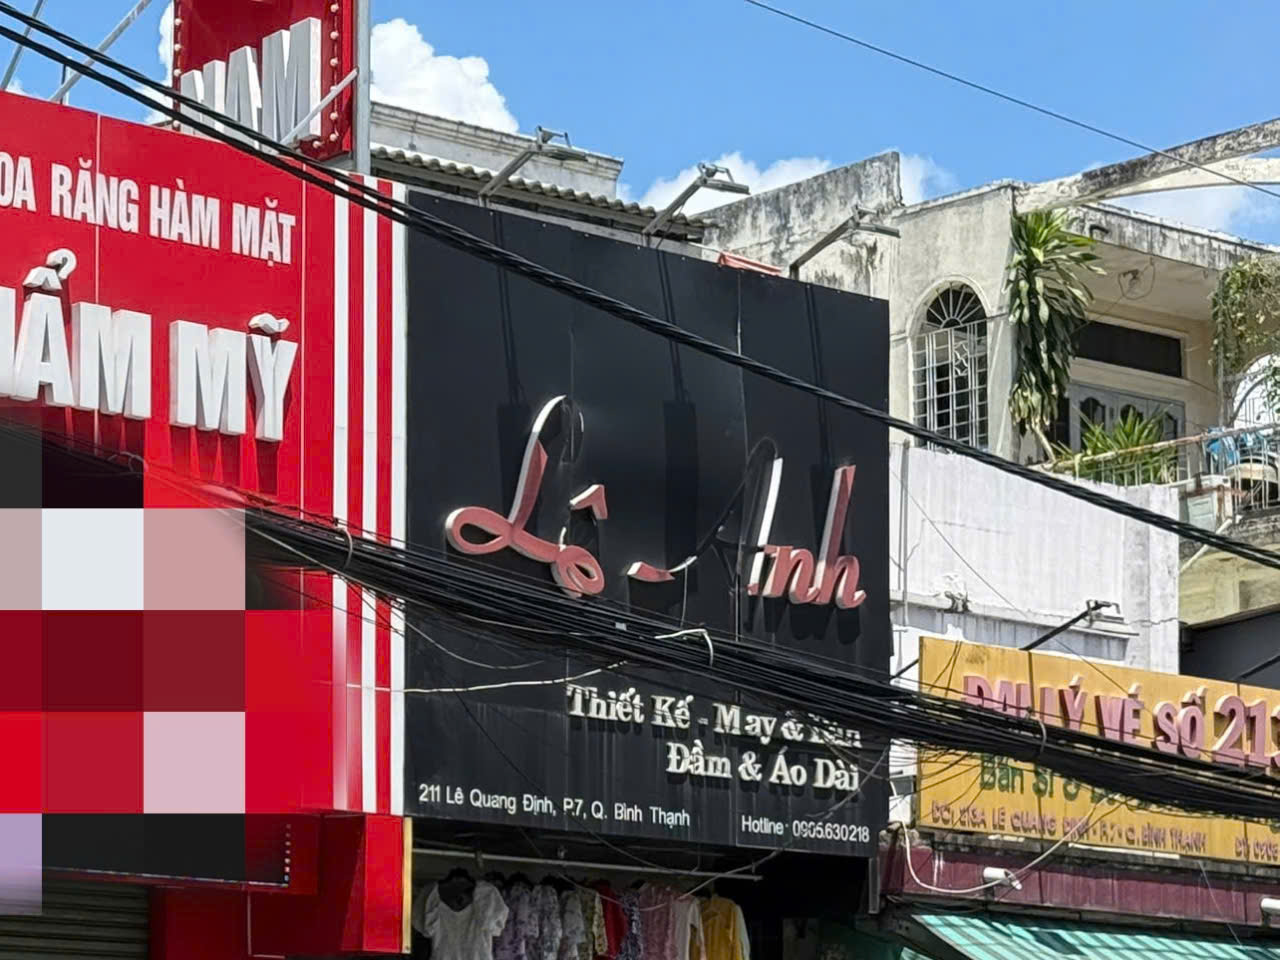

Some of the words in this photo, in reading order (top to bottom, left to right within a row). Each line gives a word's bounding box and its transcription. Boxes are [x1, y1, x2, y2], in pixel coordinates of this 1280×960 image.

[51, 156, 140, 234] RĂNG
[149, 179, 220, 250] HÀM
[231, 197, 296, 267] MẶT
[168, 312, 299, 442] MỸ
[567, 684, 644, 724] Thiết
[650, 694, 694, 729] Kế
[712, 702, 777, 745] May
[1151, 685, 1209, 759] SỐ
[666, 739, 732, 779] Đầm
[738, 750, 762, 782] &
[769, 746, 807, 787] Áo
[813, 757, 860, 792] Dài
[418, 783, 441, 802] 211
[446, 786, 464, 805] Lê
[470, 788, 517, 815] Quang
[522, 793, 557, 818] Định,
[614, 803, 643, 823] Bình
[649, 806, 691, 829] Thạnh
